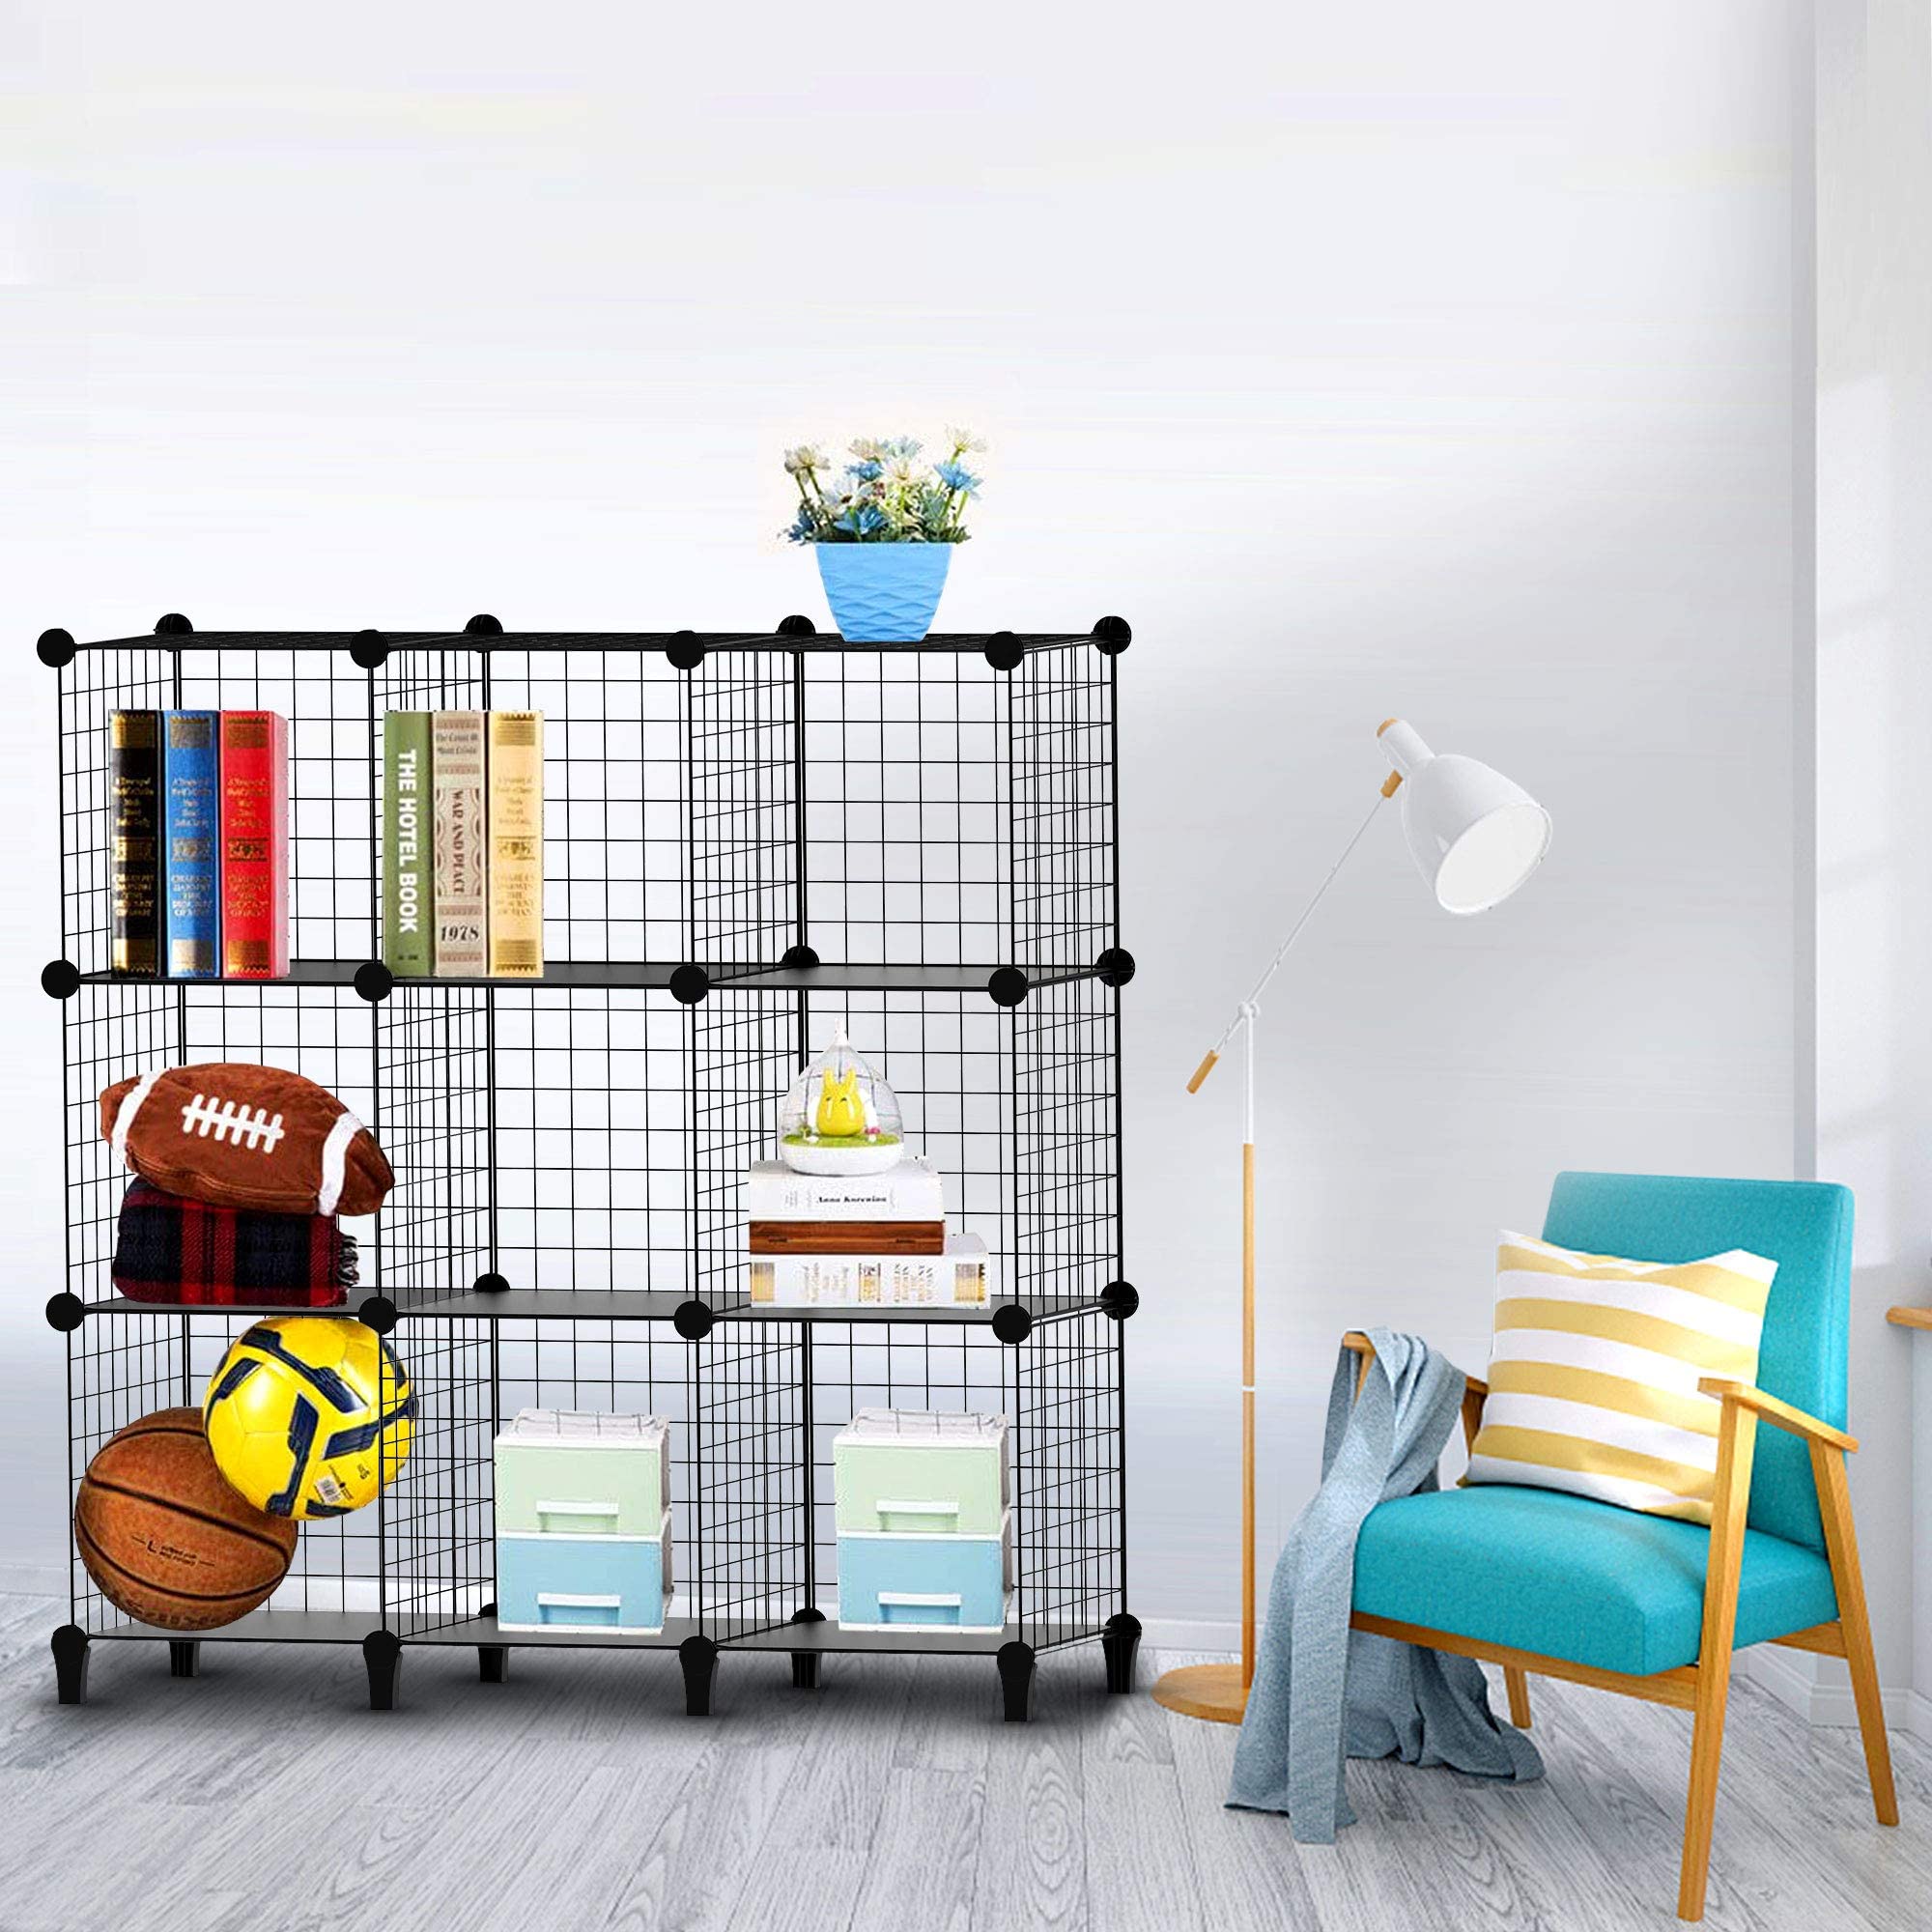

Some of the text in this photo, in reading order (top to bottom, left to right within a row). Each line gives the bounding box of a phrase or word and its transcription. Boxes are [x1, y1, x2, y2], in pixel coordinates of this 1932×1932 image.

[398, 749, 417, 791] THE
[452, 789, 464, 818] WAR
[398, 797, 417, 867] HOTEL
[452, 823, 465, 850] AND
[399, 873, 418, 933] BOOK
[440, 924, 479, 942] 1978
